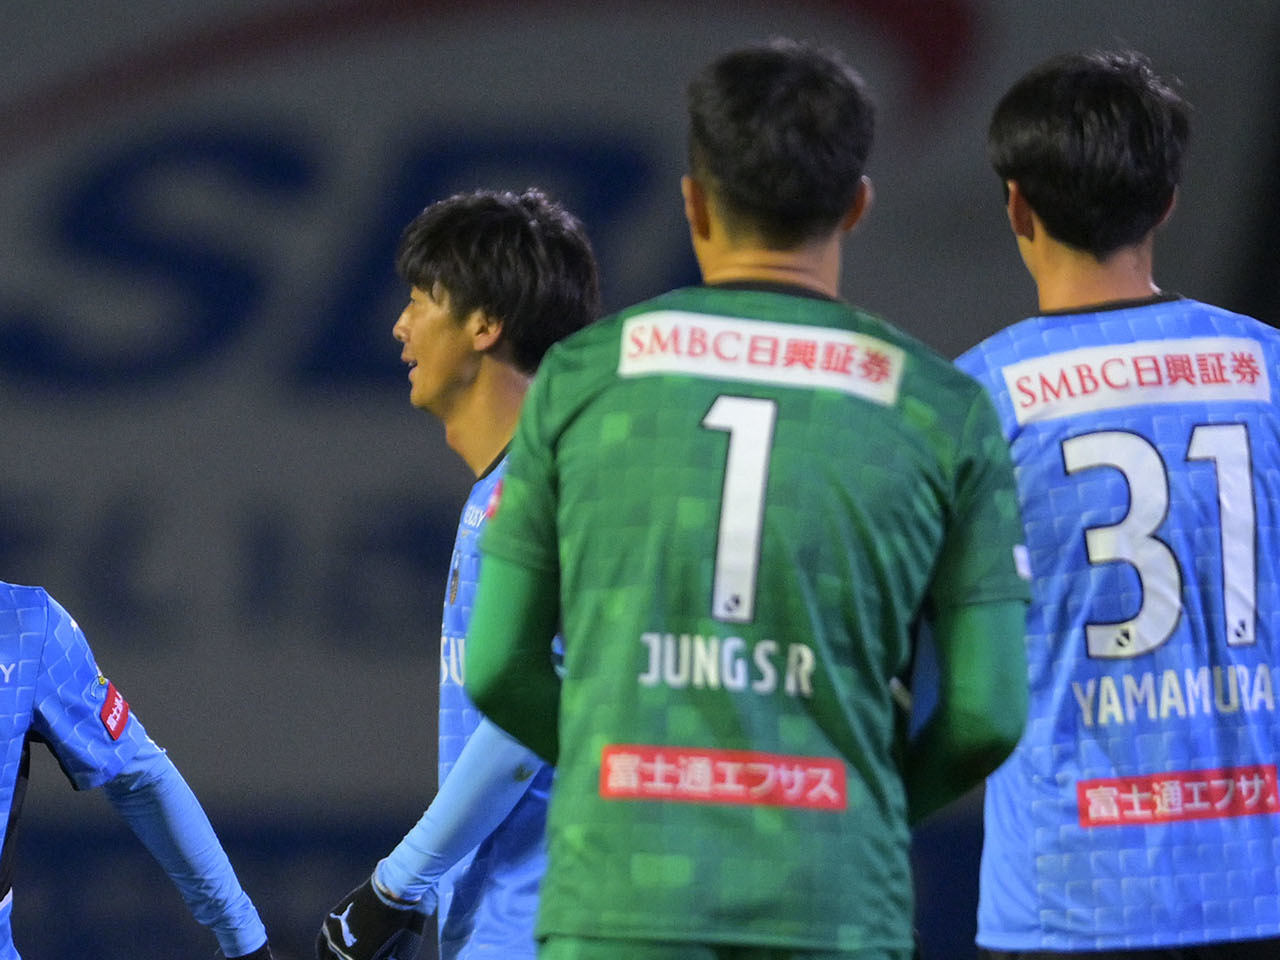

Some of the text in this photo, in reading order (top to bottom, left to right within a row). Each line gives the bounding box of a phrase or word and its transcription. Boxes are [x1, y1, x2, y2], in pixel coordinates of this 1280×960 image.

[626, 324, 892, 383] SMBC日興証券
[1016, 352, 1261, 408] SMBC日興証券
[701, 395, 776, 622] 1
[1062, 423, 1257, 659] 31
[1072, 664, 1275, 727] YAMAMURA
[607, 754, 839, 802] 富士通エフサス
